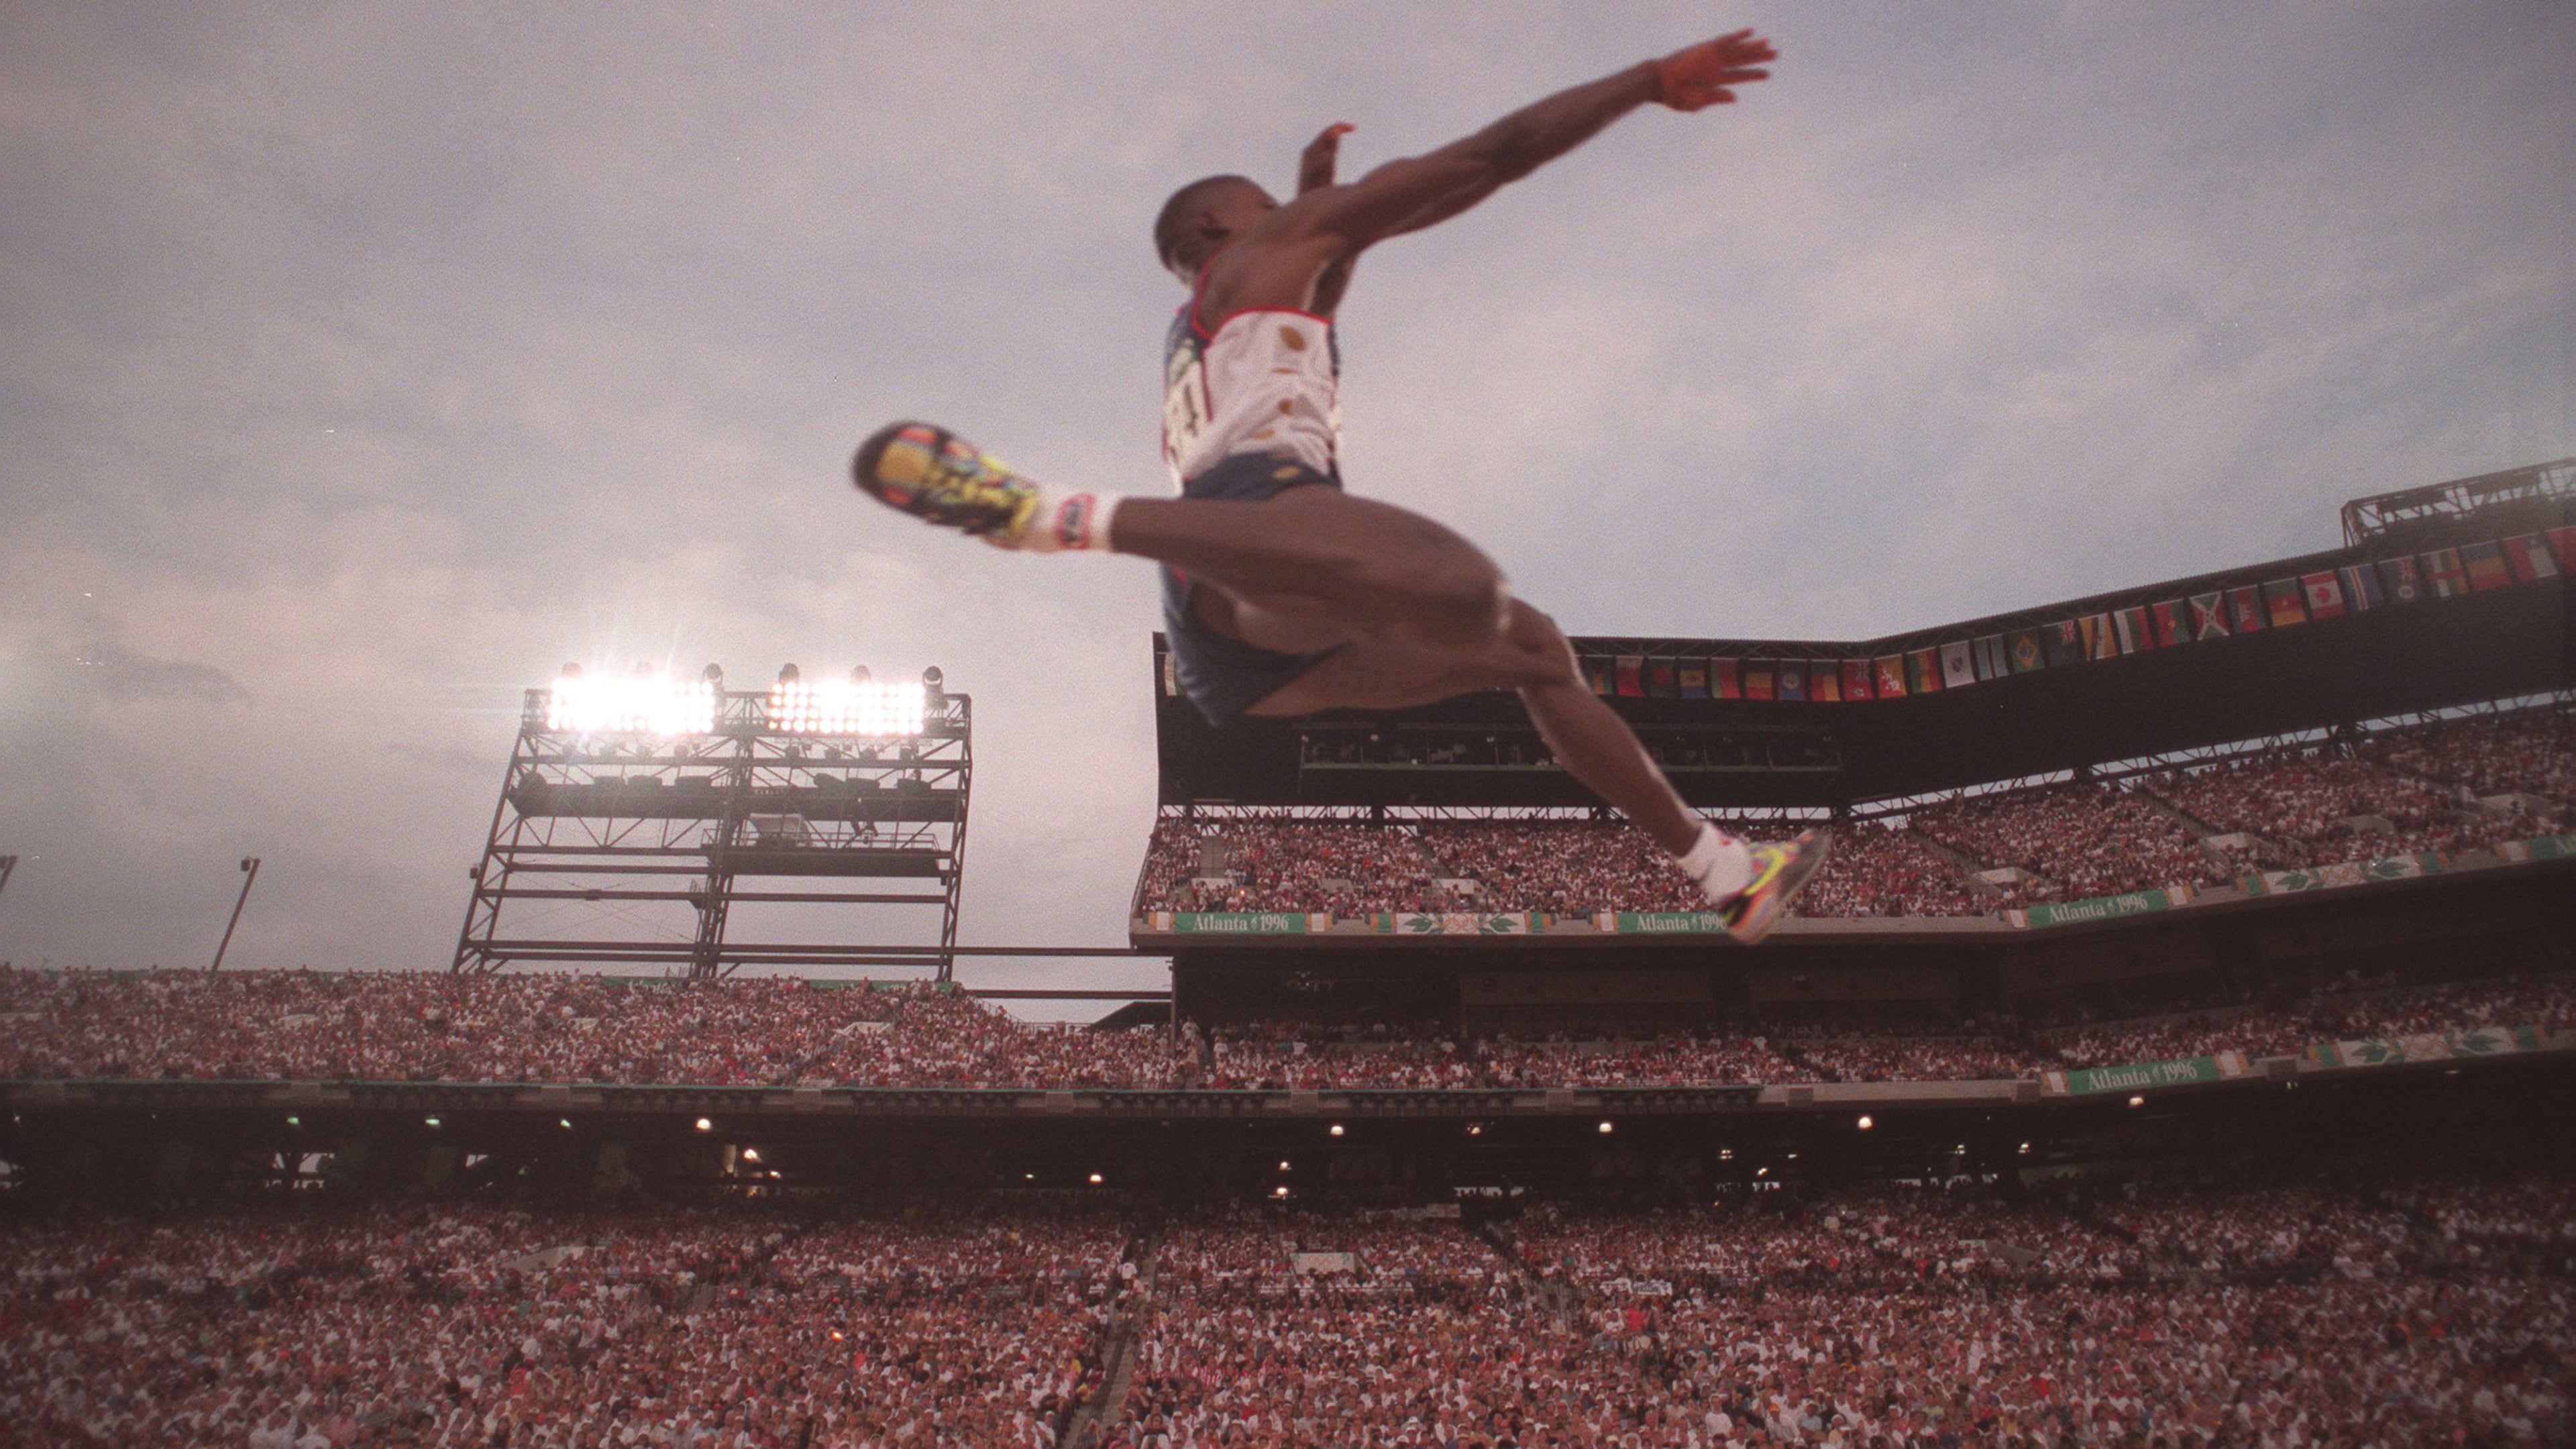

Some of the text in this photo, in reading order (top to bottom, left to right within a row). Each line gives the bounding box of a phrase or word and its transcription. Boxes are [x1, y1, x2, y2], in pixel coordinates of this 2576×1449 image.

[2049, 894, 2148, 923] Atlanta 1996
[1193, 913, 1288, 930] Atlanta 1996
[1637, 914, 1689, 930] Atlanta
[2088, 1061, 2198, 1090] Atlanta 1996
